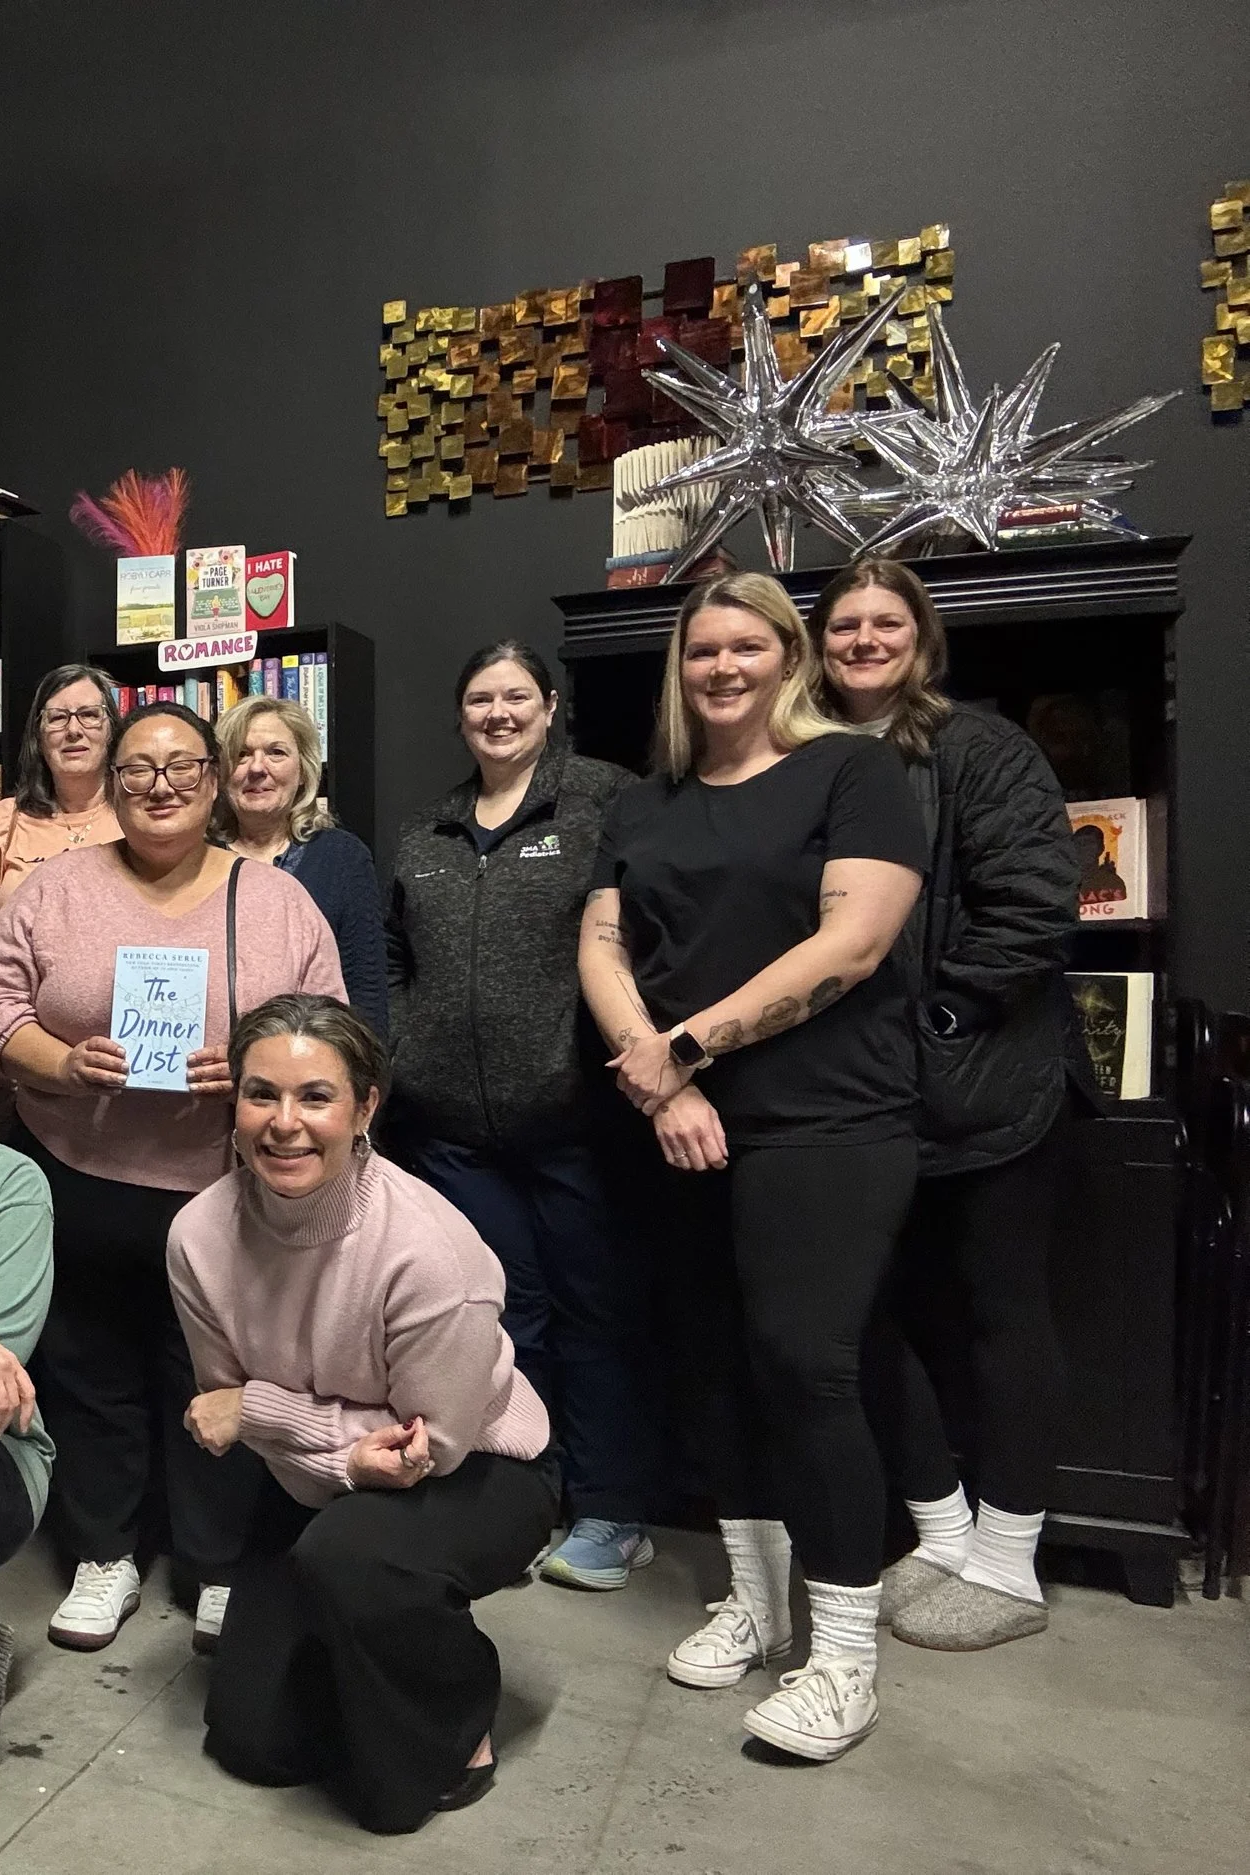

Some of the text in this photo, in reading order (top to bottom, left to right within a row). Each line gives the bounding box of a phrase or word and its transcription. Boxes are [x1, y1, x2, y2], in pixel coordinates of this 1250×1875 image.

[210, 566, 227, 577] PAGE
[255, 558, 283, 573] HATE
[202, 577, 229, 588] TURNER
[164, 635, 254, 663] ROMANCE
[1080, 904, 1114, 916] ONG
[123, 953, 203, 963] REBECCA SERLE
[144, 977, 178, 1001] The
[118, 1008, 200, 1039] Dinner
[130, 1044, 181, 1074] List
